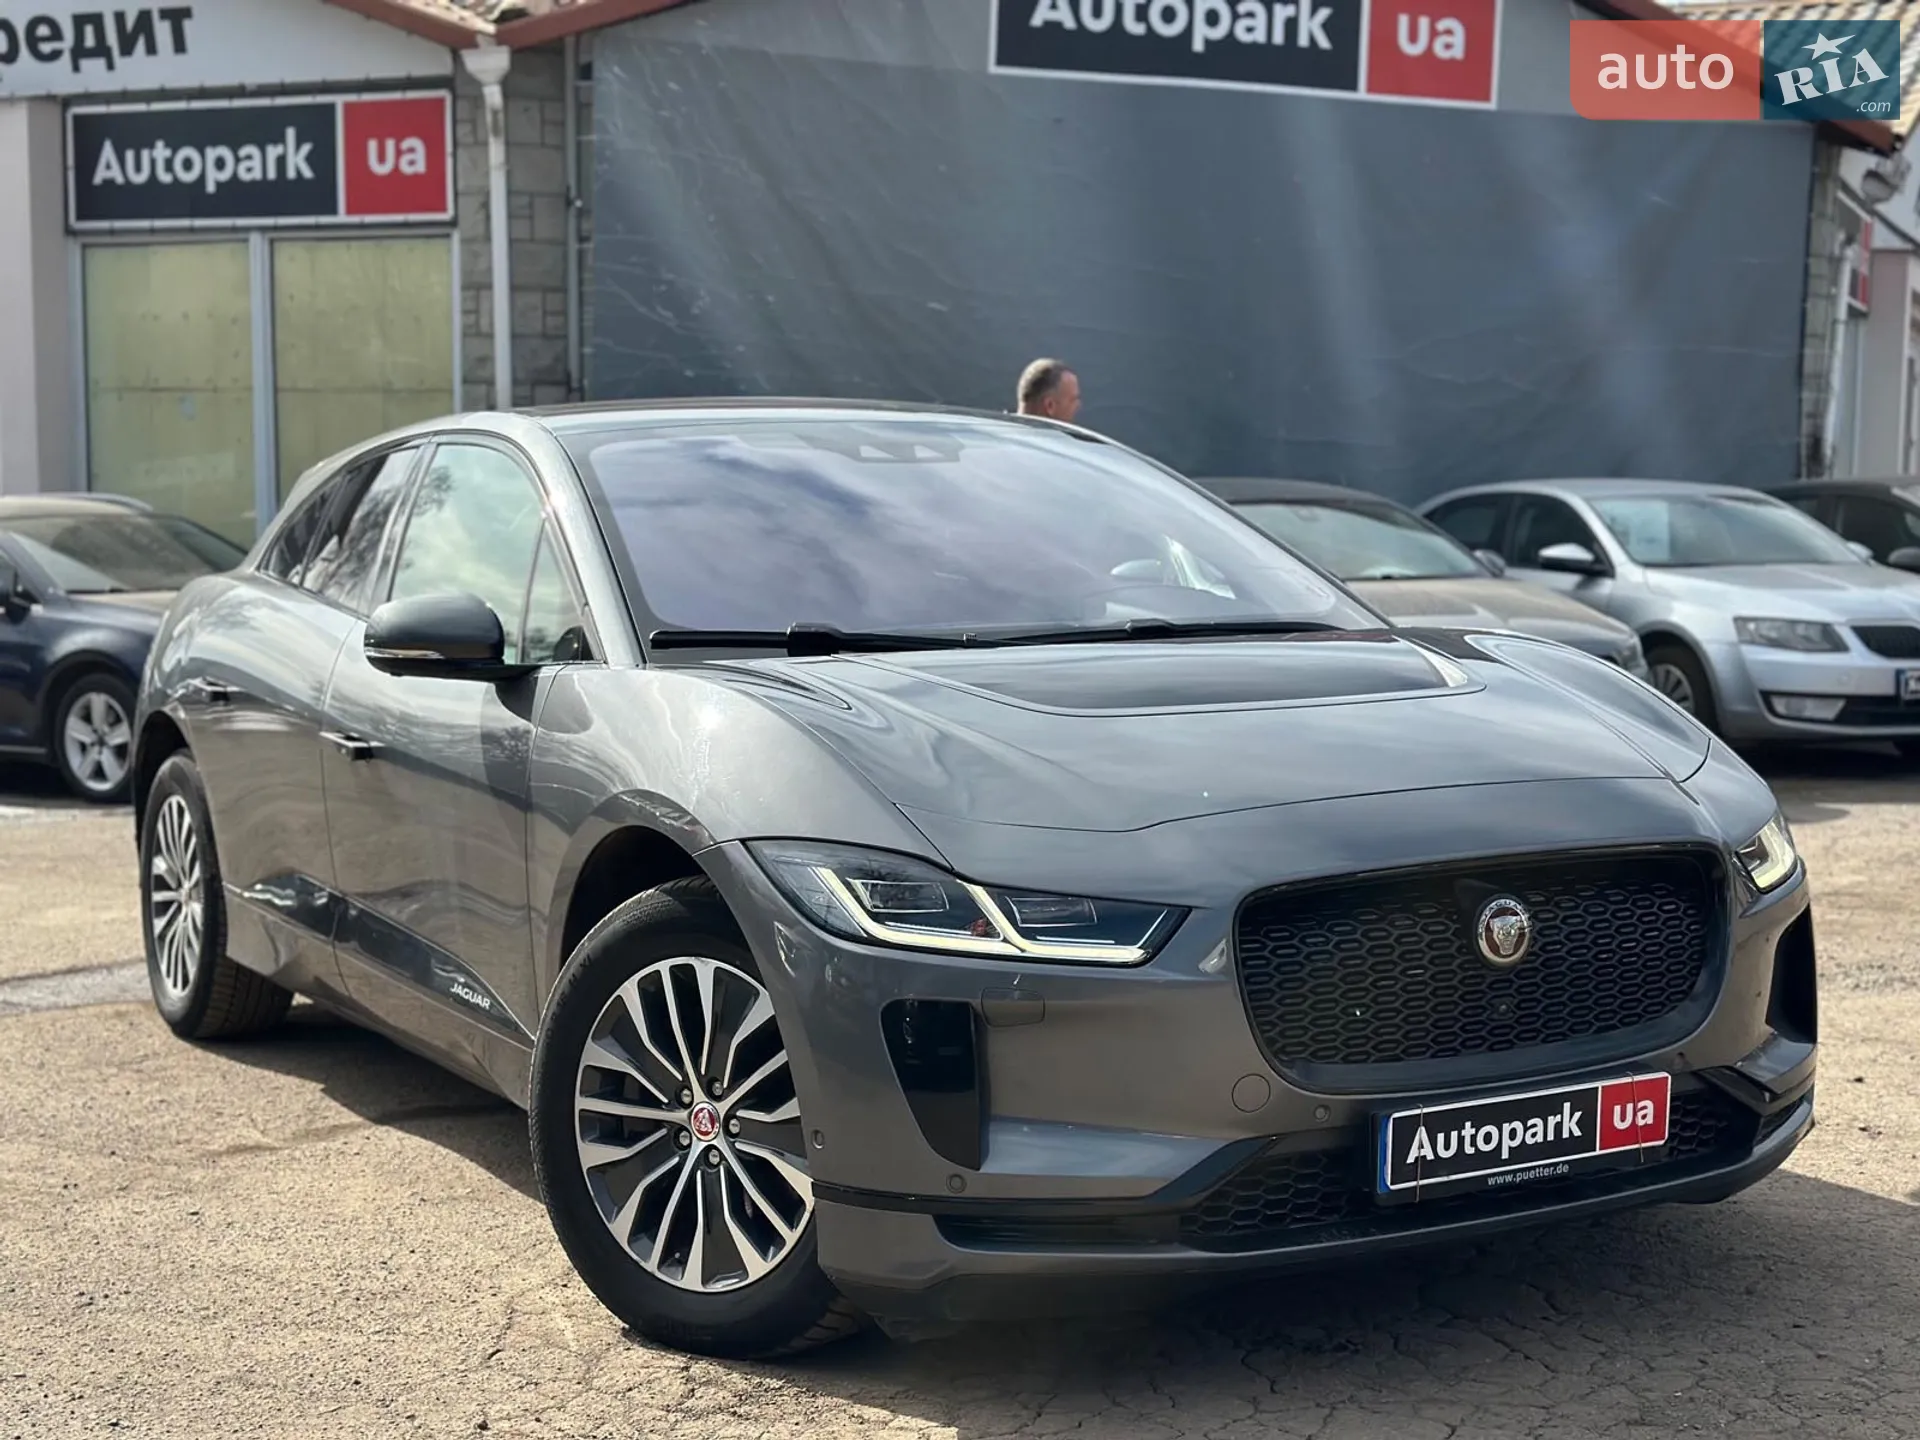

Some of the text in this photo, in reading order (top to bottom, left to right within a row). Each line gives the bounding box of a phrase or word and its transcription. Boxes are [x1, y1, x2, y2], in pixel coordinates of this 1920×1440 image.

[1397, 13, 1466, 61] ua
[92, 127, 427, 194] Autopark ua
[449, 982, 491, 1010] JAGUAR
[1406, 1098, 1655, 1164] Autopark ua
[1487, 1163, 1570, 1187] www.puetter.de
